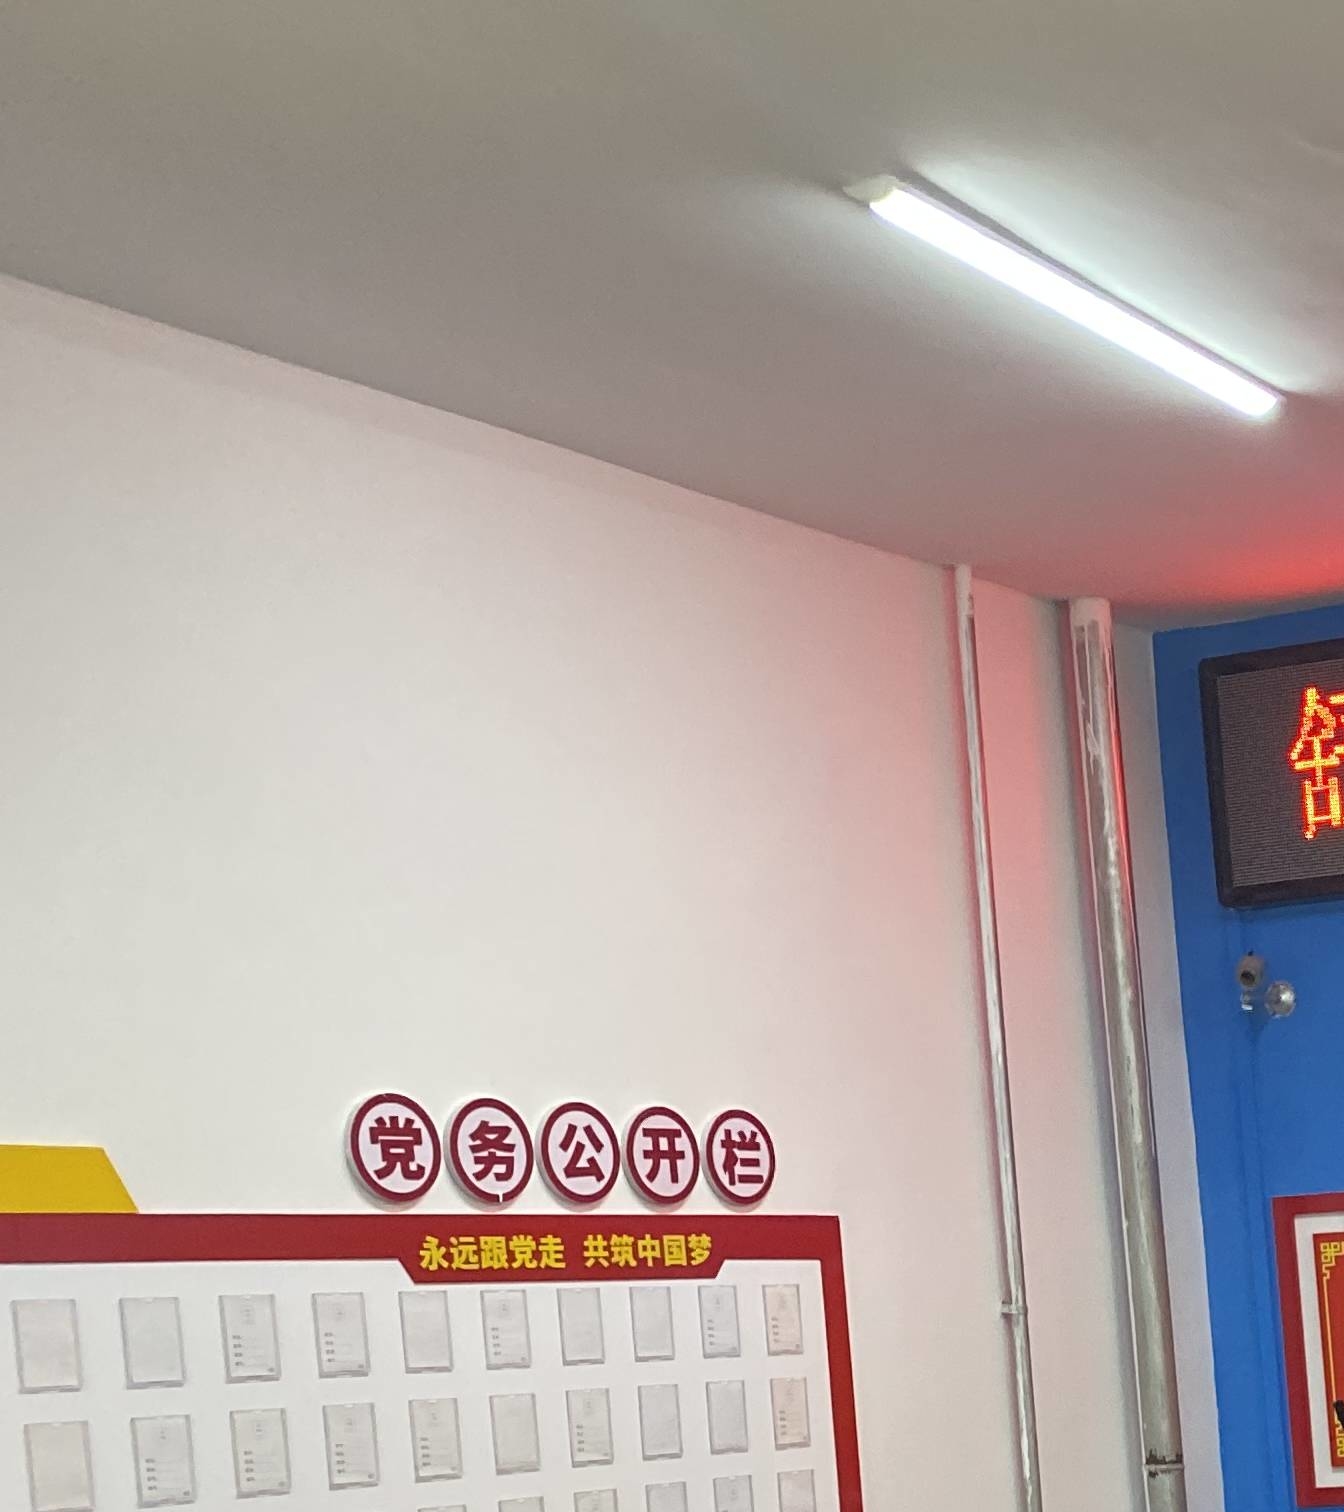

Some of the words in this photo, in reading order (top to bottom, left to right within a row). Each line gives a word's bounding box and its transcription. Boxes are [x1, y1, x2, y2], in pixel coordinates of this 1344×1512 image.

[368, 1115, 765, 1187] 党务公开栏
[420, 1235, 566, 1271] 永远跟党走
[583, 1233, 712, 1268] 共筑中国梦
